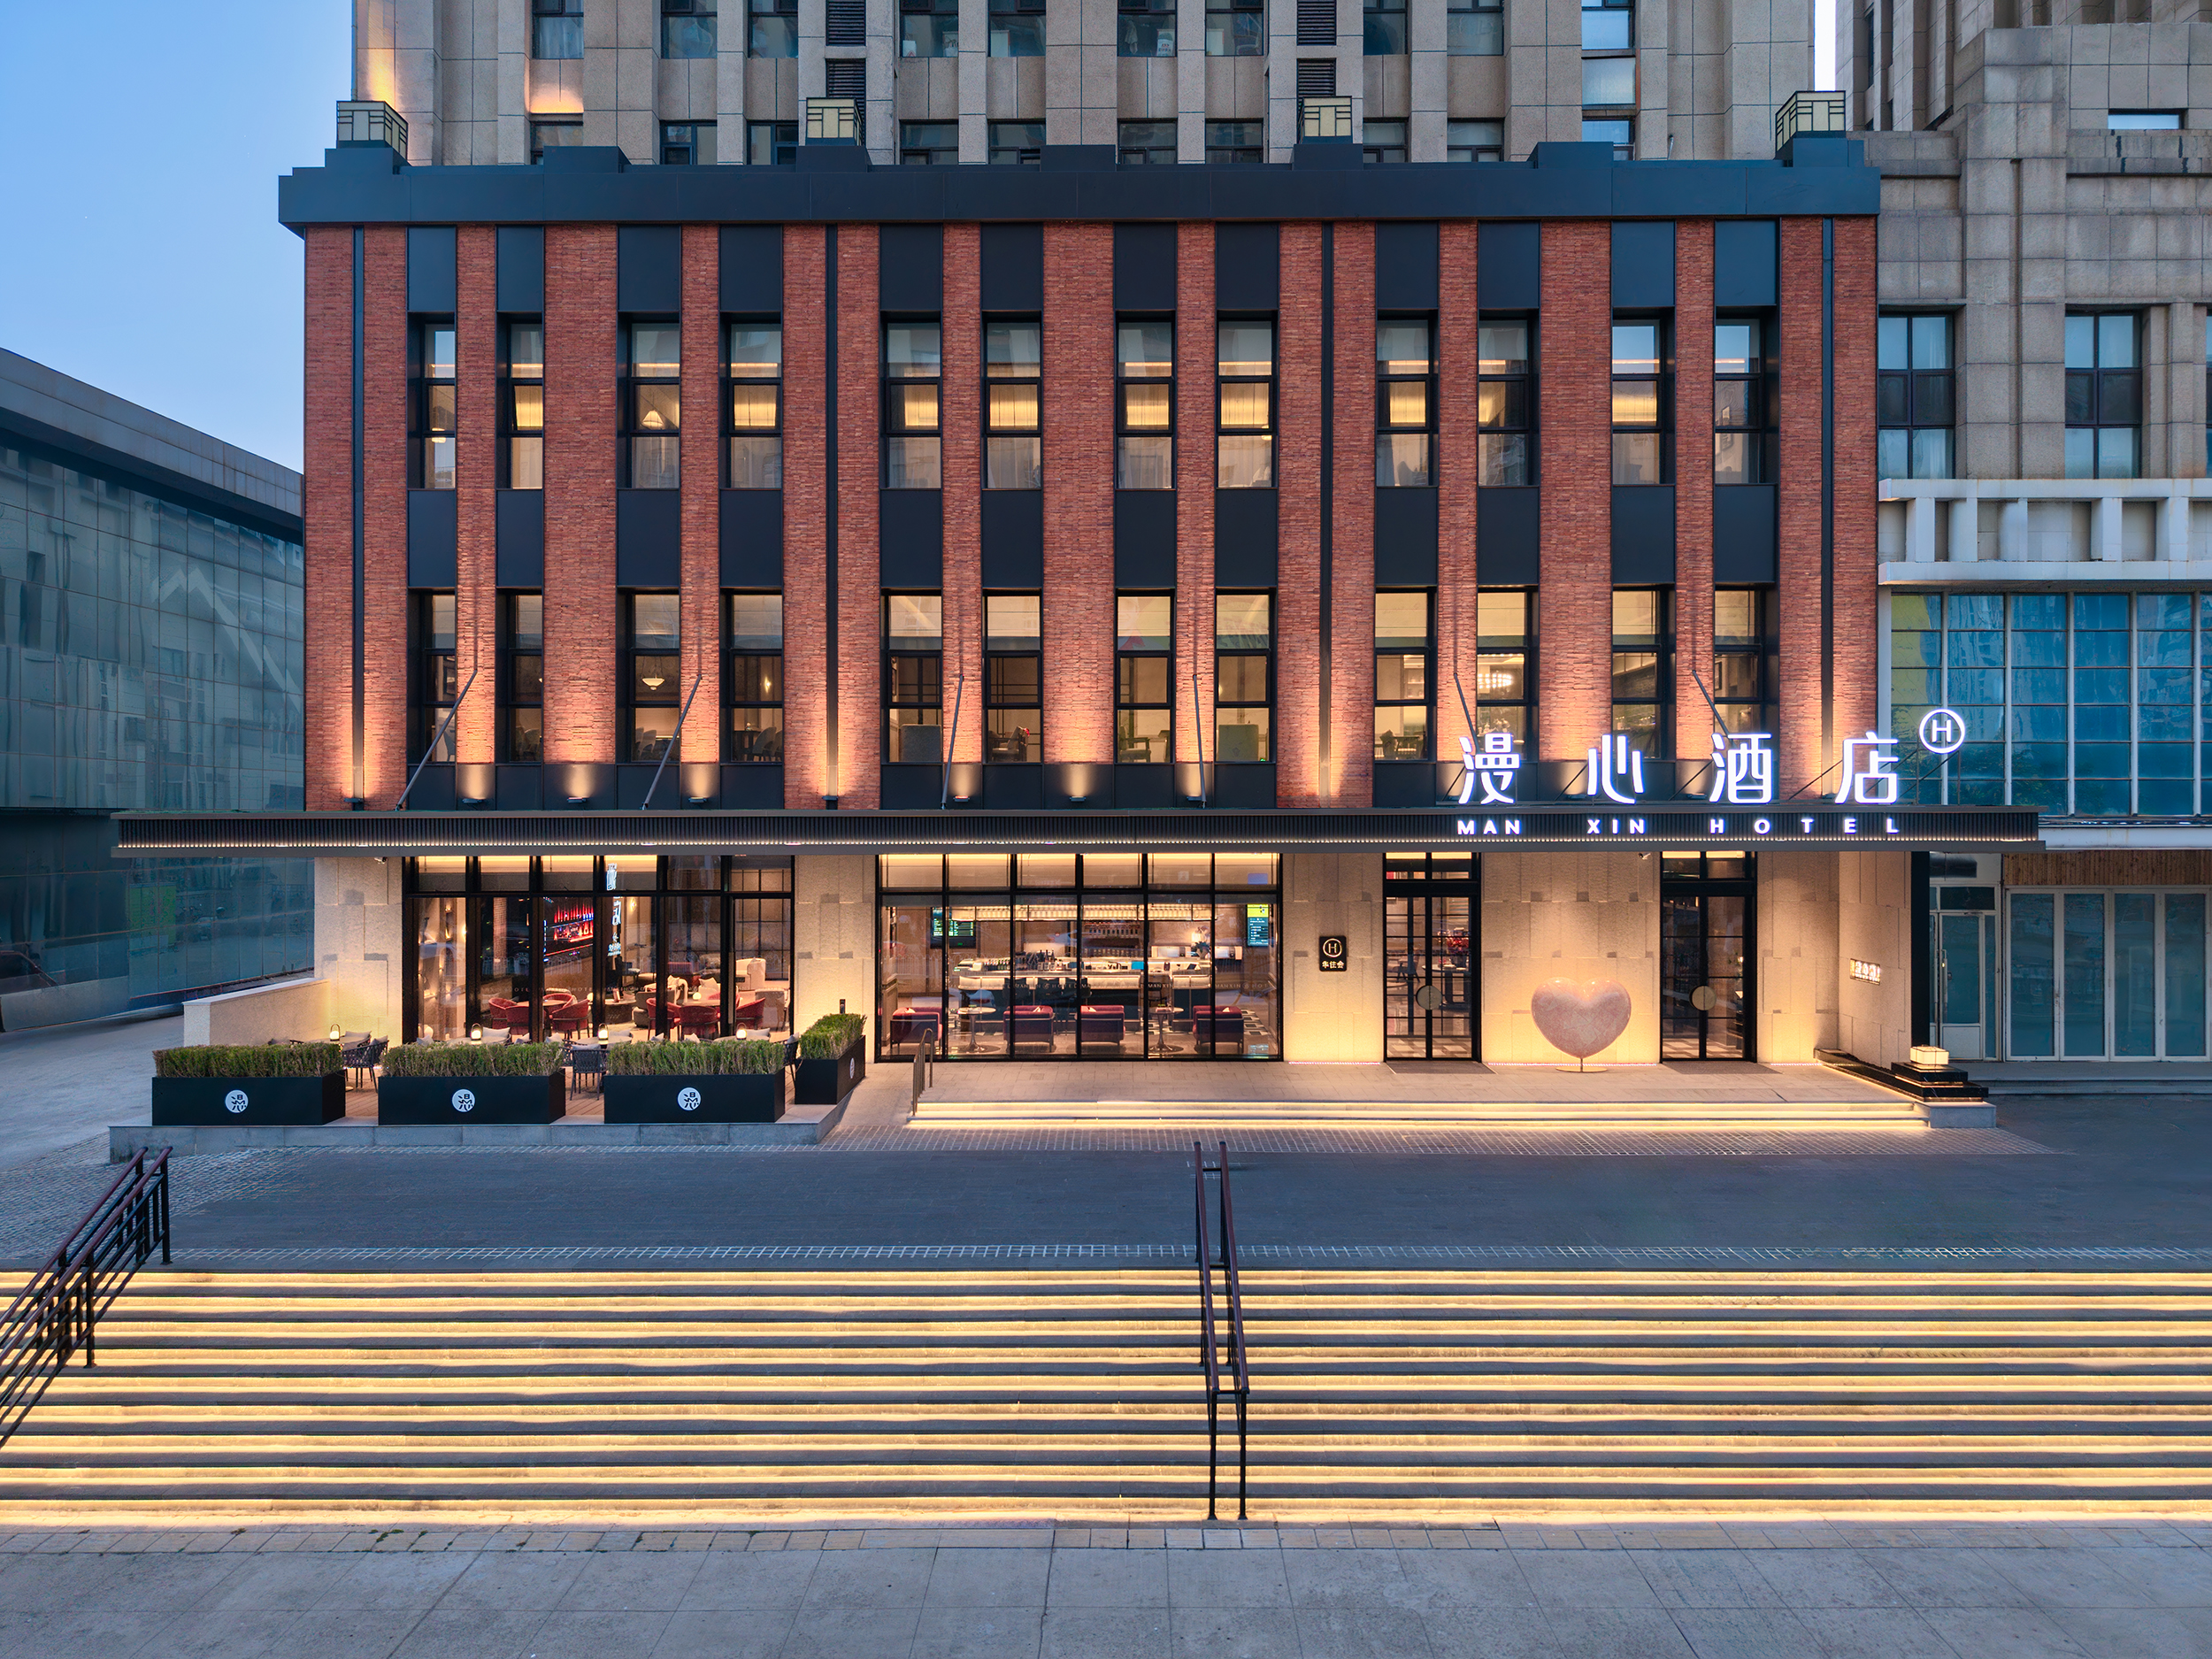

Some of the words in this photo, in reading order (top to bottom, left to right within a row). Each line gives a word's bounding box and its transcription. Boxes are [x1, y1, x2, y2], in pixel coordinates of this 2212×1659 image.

[1458, 731, 1900, 804] 漫心酒店
[1457, 819, 1520, 835] MAN
[1587, 819, 1645, 834] XIN
[1710, 819, 1900, 834] HOTEL
[1321, 960, 1345, 970] 华住会
